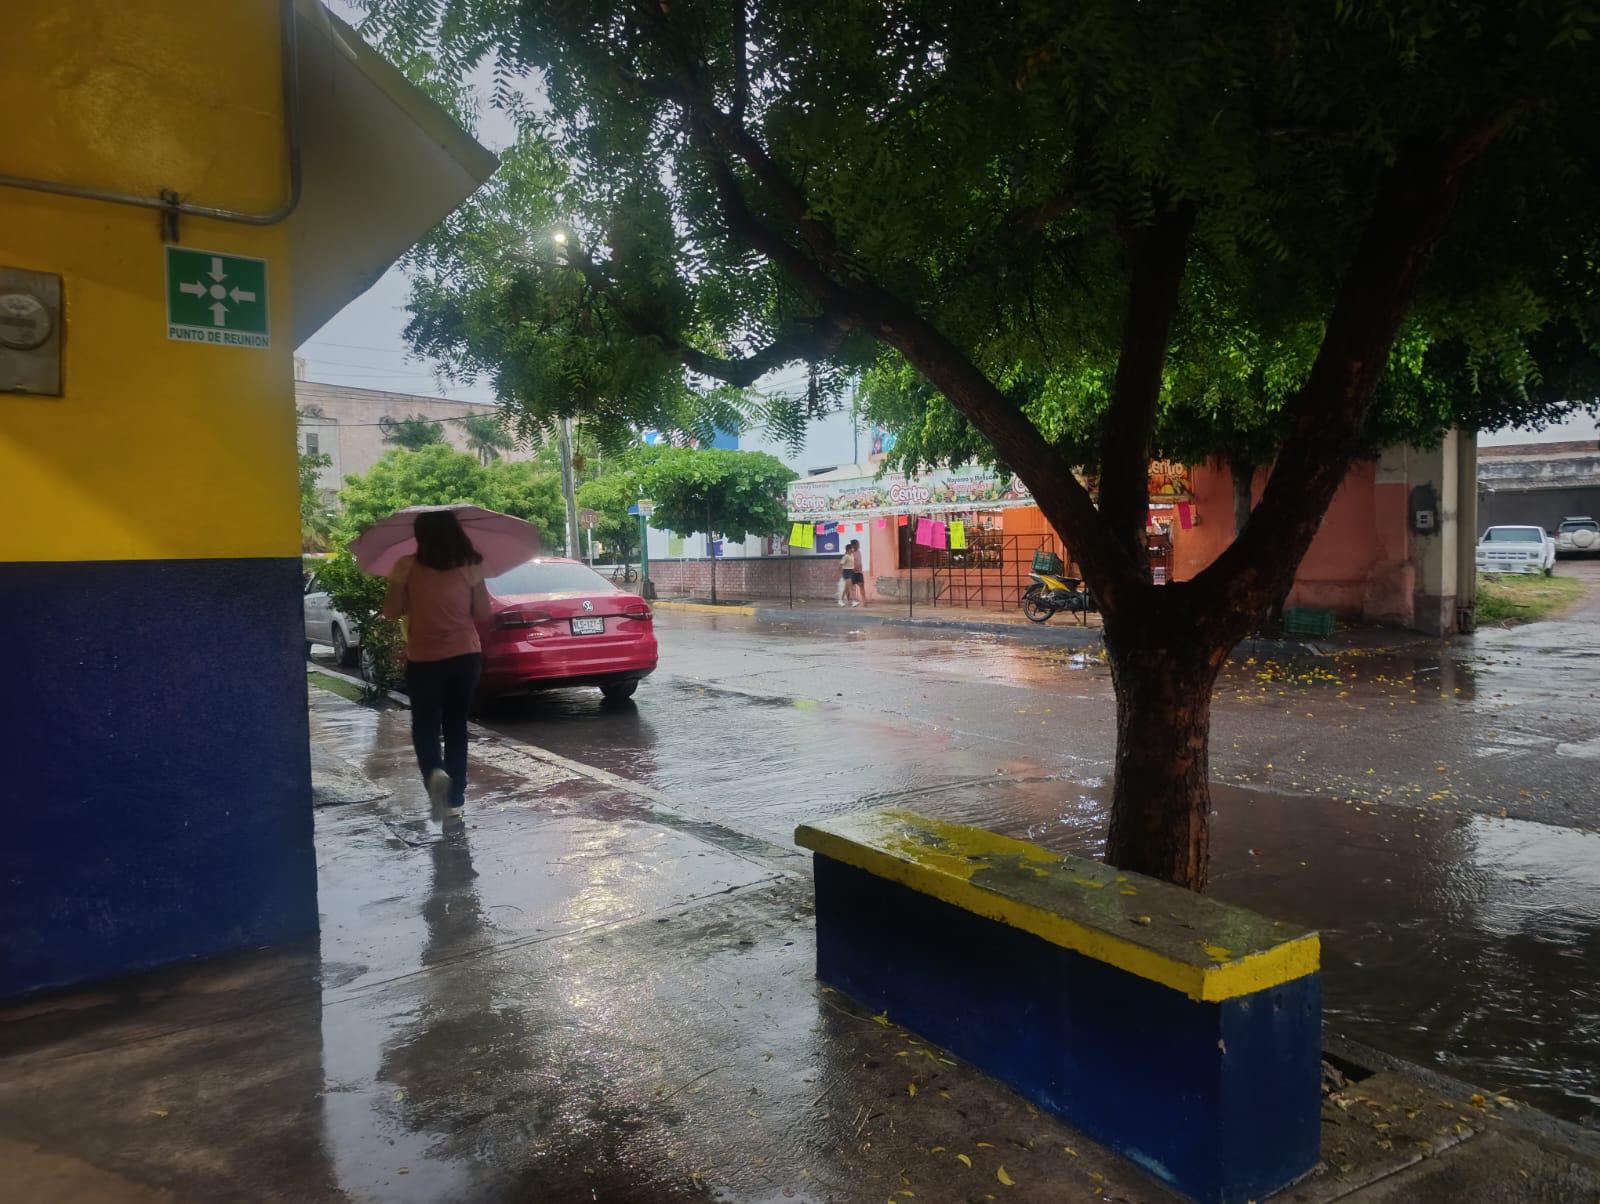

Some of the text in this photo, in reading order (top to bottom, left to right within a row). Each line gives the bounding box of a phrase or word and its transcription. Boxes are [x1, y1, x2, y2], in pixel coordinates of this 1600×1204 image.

[169, 327, 269, 348] PUNTO DE REUNION
[1147, 459, 1184, 476] entro
[794, 492, 826, 510] Centro
[889, 484, 930, 502] Centro
